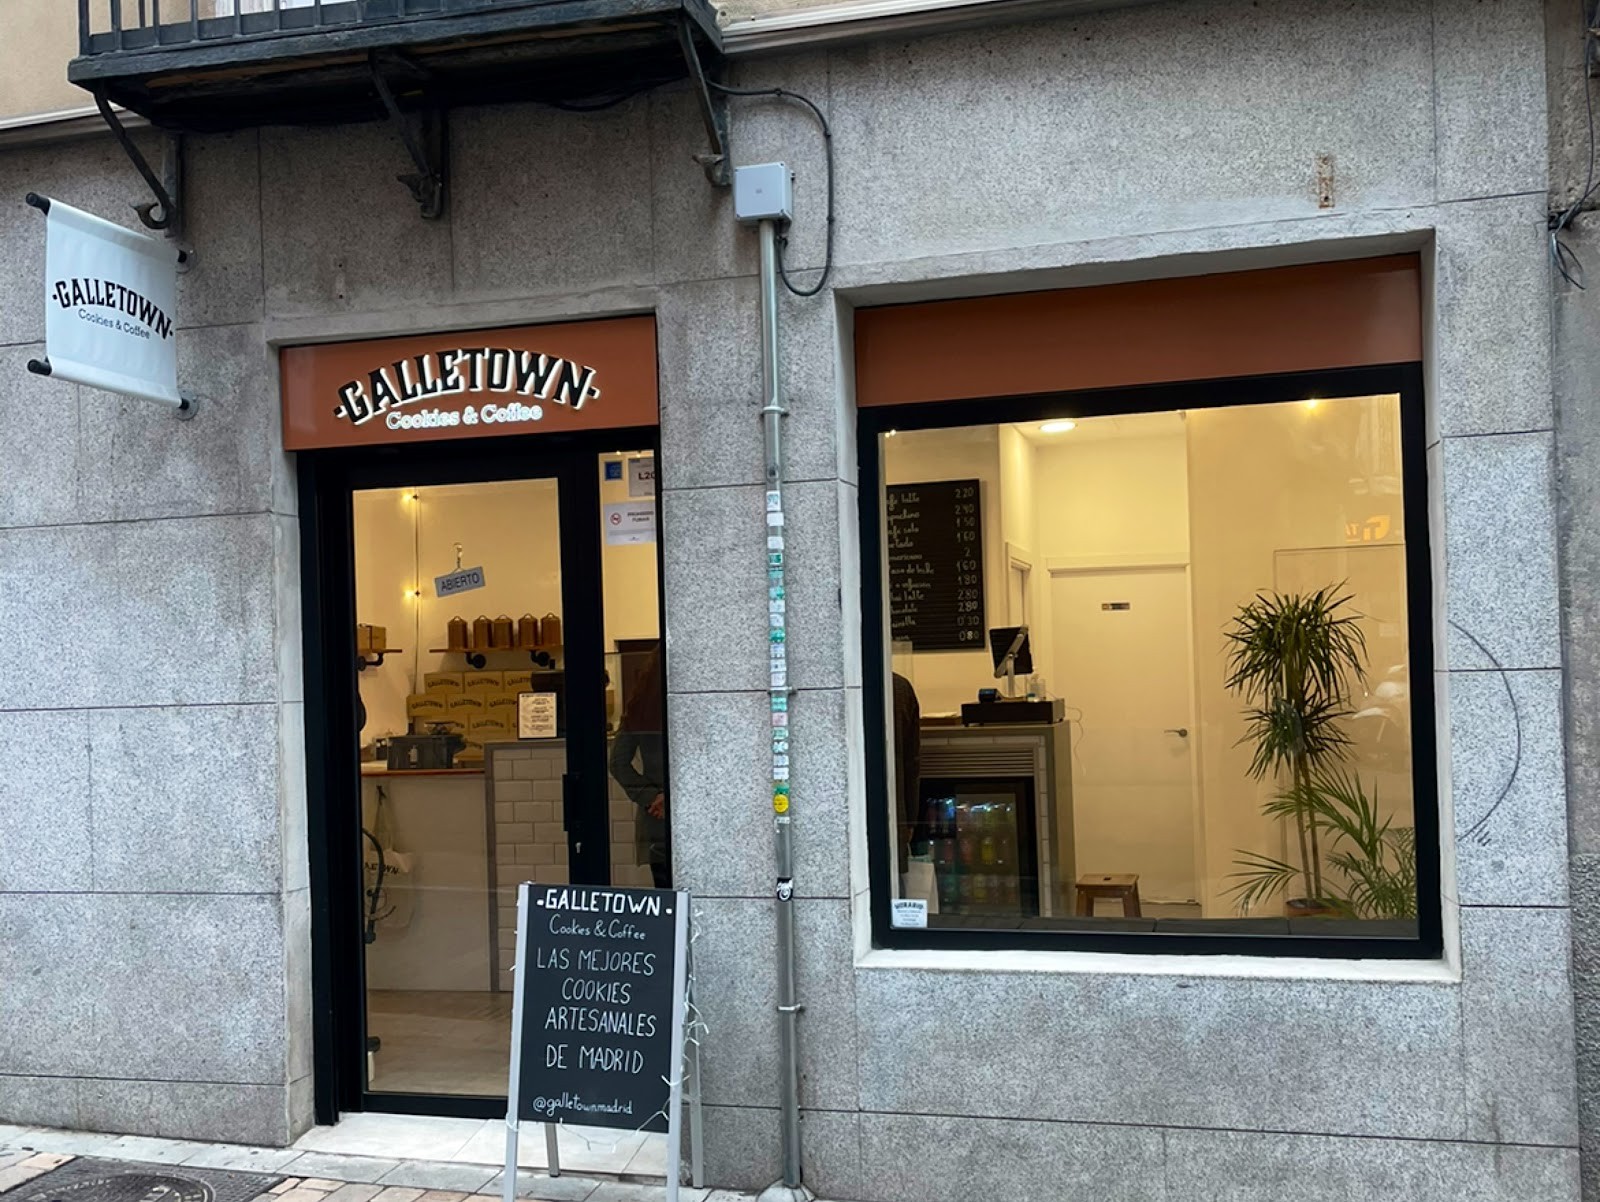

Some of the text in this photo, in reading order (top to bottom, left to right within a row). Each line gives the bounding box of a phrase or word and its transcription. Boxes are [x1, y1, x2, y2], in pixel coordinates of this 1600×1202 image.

[55, 278, 171, 340] GALLETOWN
[78, 308, 150, 339] Cookies & Coffee
[337, 347, 597, 425] GALLETOWN
[386, 403, 543, 430] Cookies & Coffee
[441, 571, 480, 592] ABIERTO
[545, 889, 660, 916] GALLETOWN
[549, 913, 646, 940] Cookies & Coffee
[537, 948, 656, 976] LAS MEJORES
[562, 977, 631, 1005] COOKIES
[544, 1006, 657, 1037] ARTESANALES
[546, 1044, 644, 1073] DE MADRID
[533, 1092, 633, 1116] @galletownmadrid
